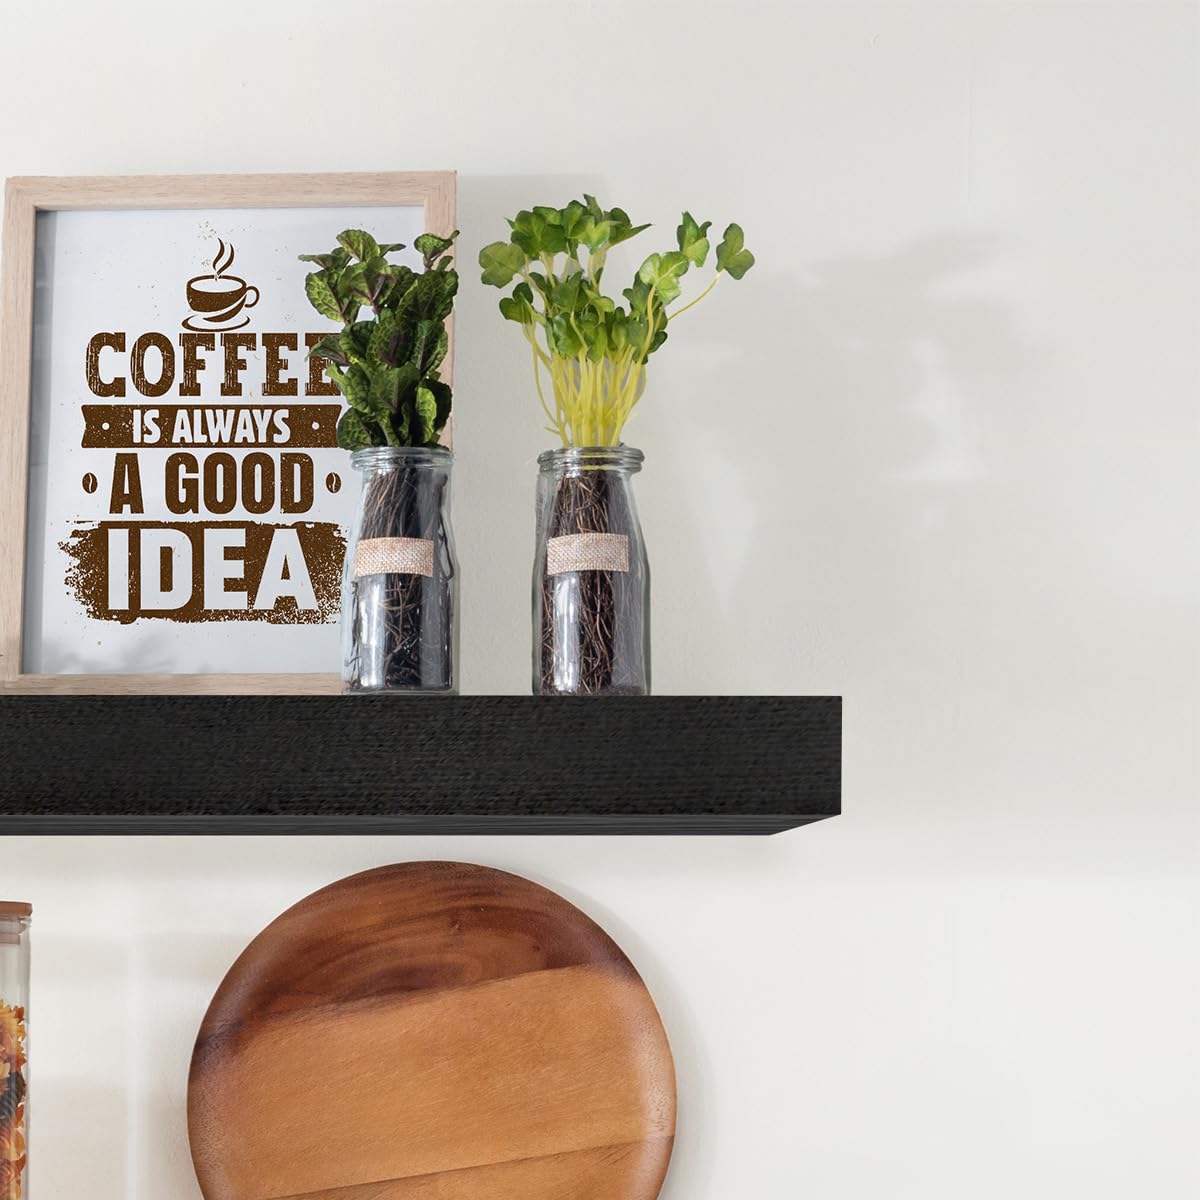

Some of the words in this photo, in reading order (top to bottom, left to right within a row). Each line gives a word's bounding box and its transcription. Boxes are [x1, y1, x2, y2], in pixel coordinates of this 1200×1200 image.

[132, 408, 161, 443] IS
[172, 408, 291, 444] ALWAYS
[109, 452, 145, 514] A
[165, 452, 314, 514] GOOD
[107, 528, 319, 610] IDEA
